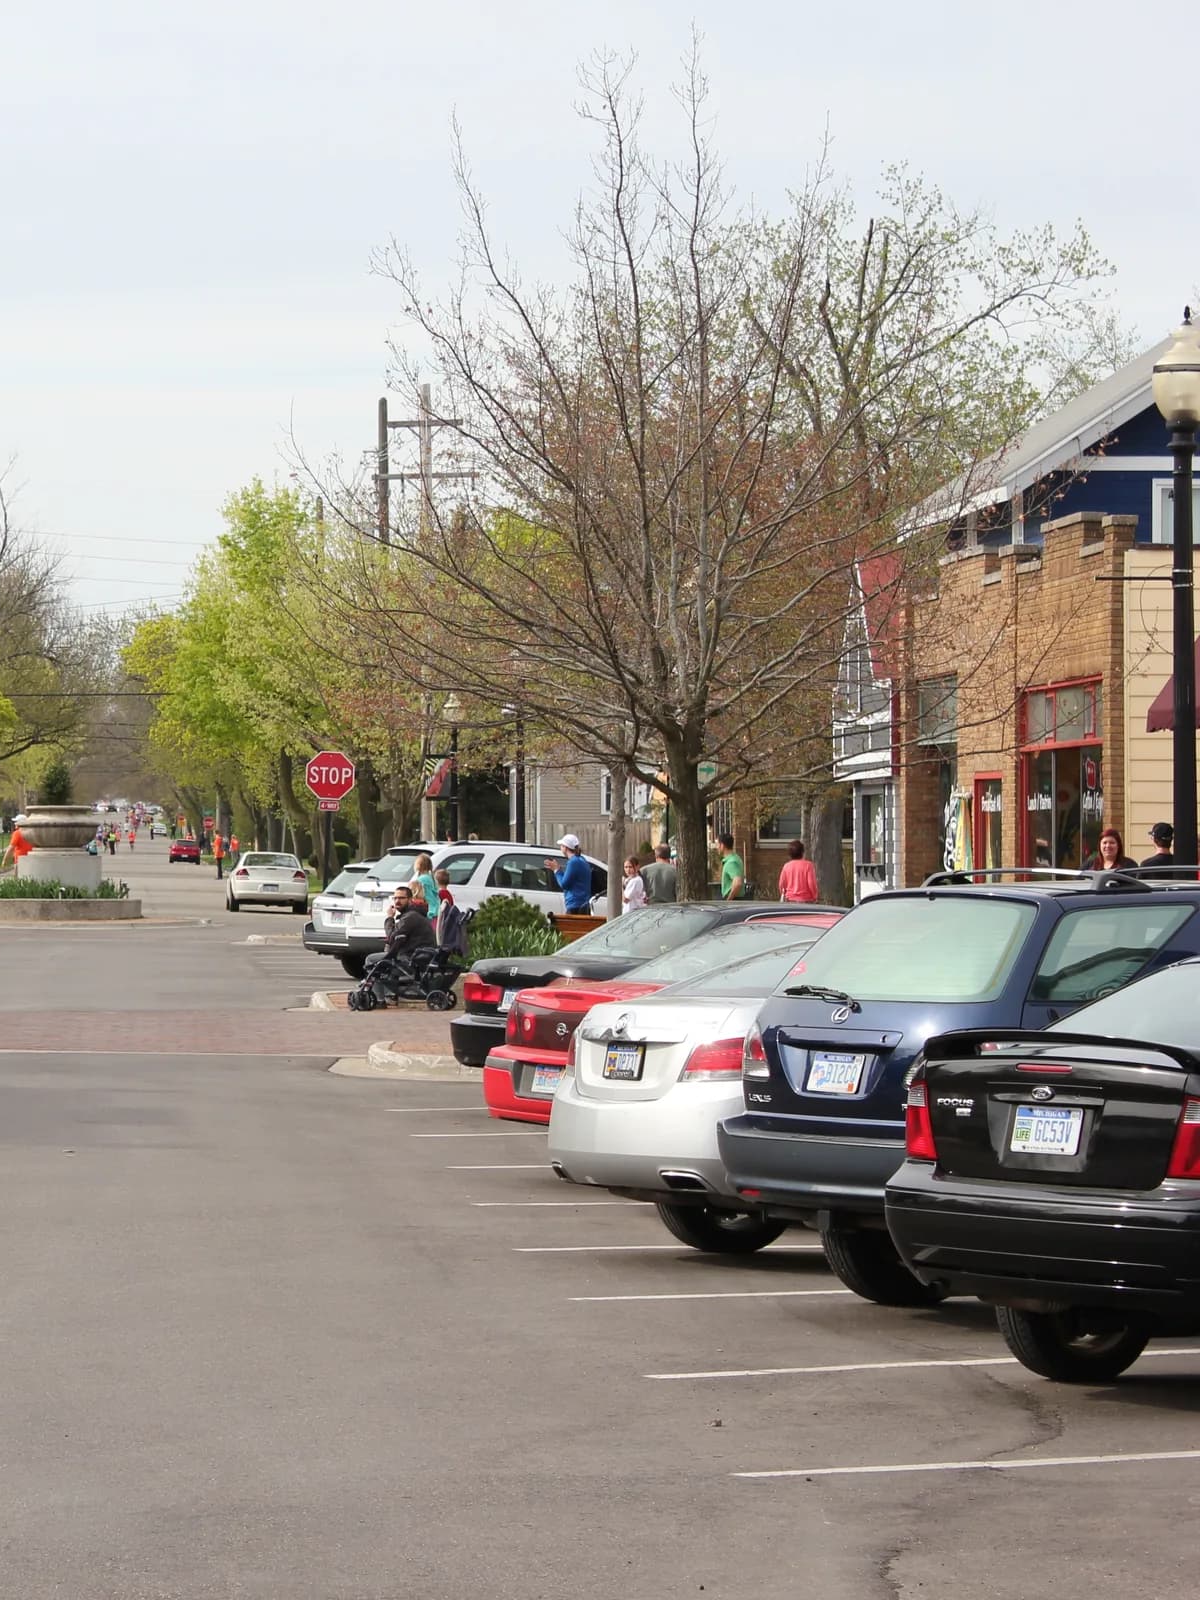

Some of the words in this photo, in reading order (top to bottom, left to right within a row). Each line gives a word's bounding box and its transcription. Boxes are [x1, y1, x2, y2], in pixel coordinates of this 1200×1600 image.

[309, 766, 352, 785] STOP
[937, 1098, 974, 1107] FOCUS
[1033, 1109, 1066, 1118] MICHIGAN
[1016, 1128, 1031, 1139] LIFE
[1034, 1119, 1073, 1144] GC53V
